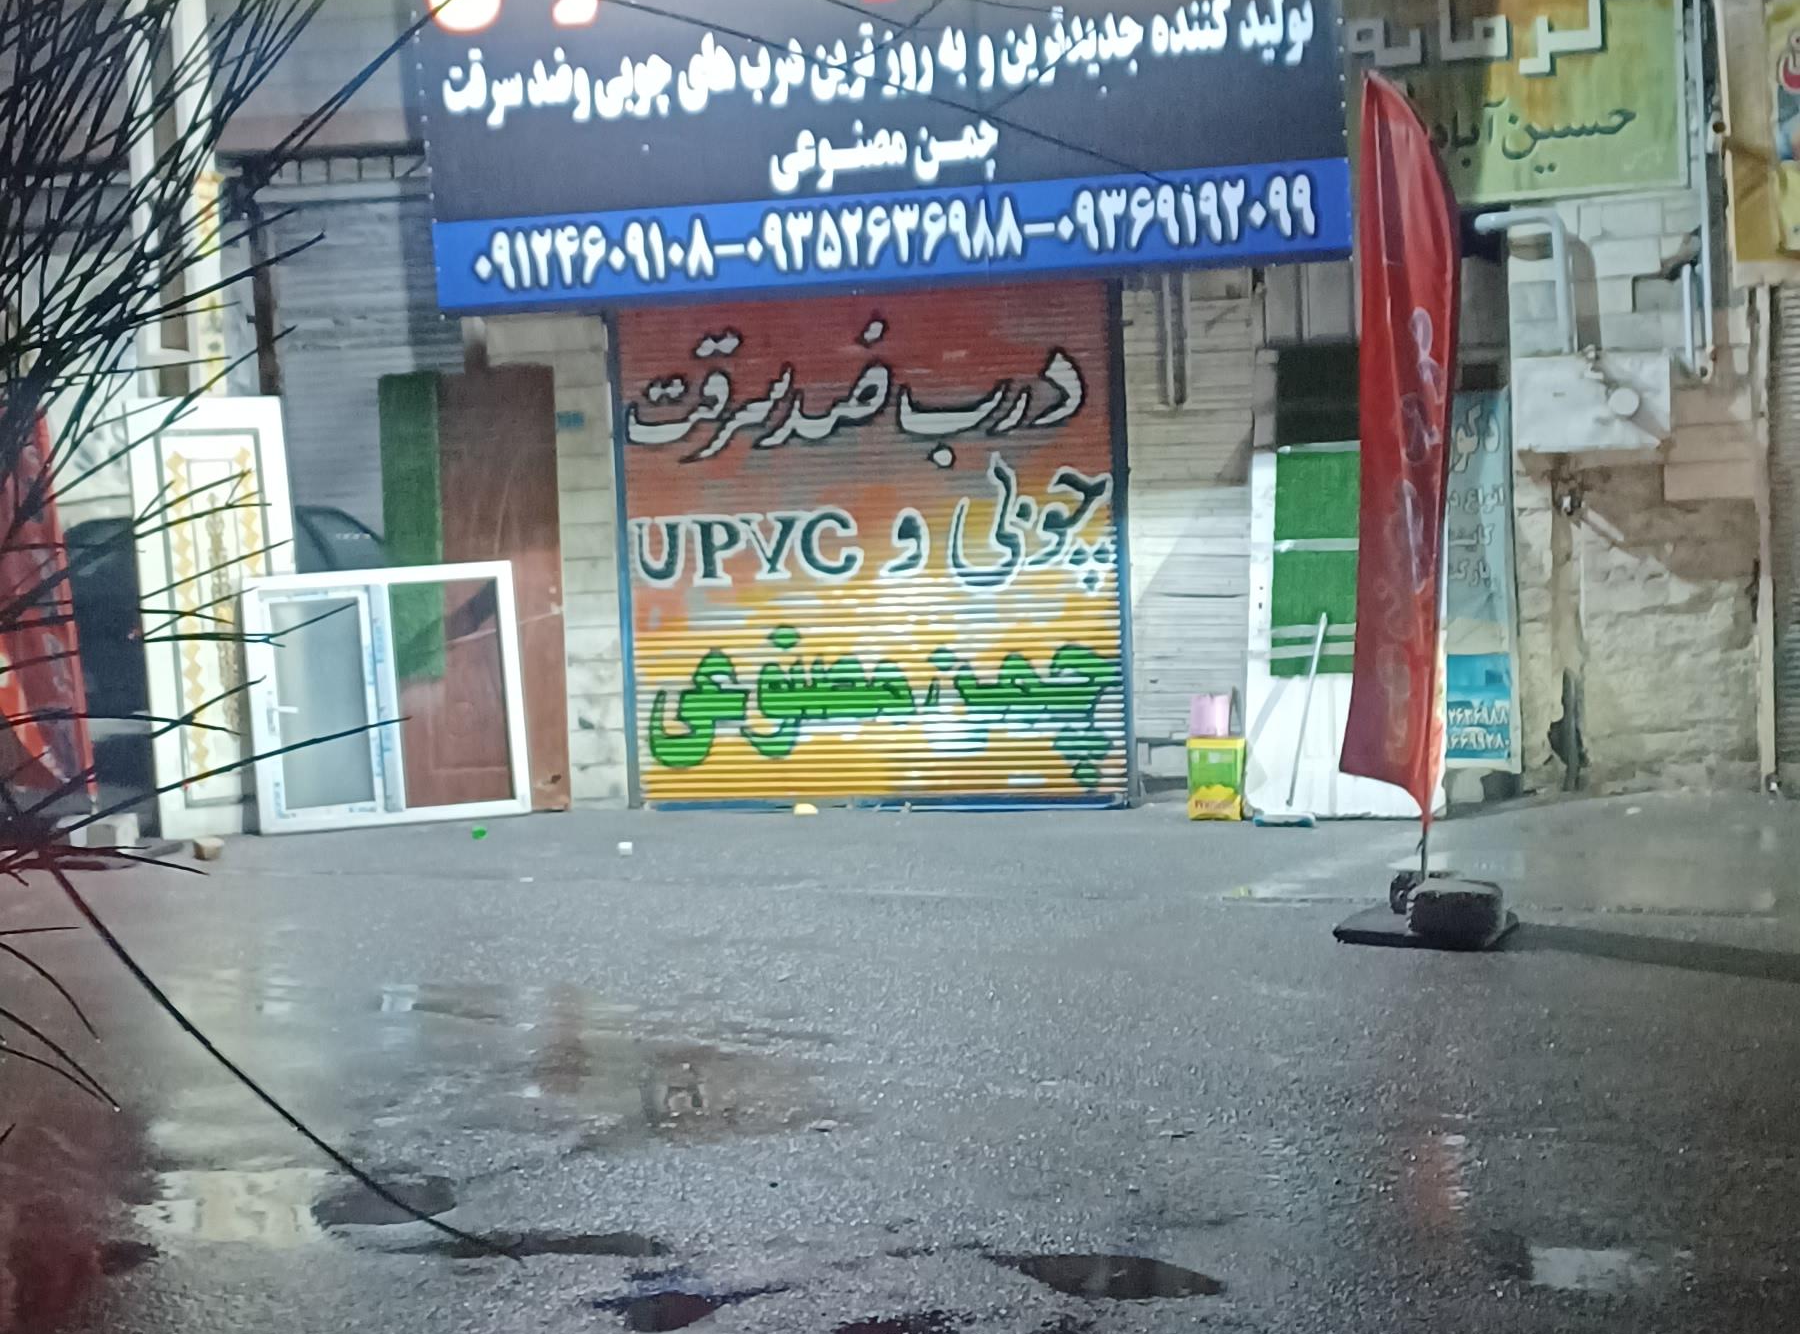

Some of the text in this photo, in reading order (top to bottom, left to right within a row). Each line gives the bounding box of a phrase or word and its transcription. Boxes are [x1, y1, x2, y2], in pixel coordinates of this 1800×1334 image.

[678, 32, 736, 113] های
[740, 38, 806, 106] درب
[811, 22, 876, 100] ترین
[881, 30, 934, 96] روز
[938, 26, 967, 87] به
[978, 34, 996, 88] و
[1000, 6, 1143, 85] جدیدترین
[442, 49, 523, 128] سرقت
[594, 53, 672, 118] چوبی
[769, 118, 999, 192] چمن مصنوعی
[1501, 108, 1636, 174] حسین
[626, 317, 1086, 468] درب ضد سرقت
[629, 507, 865, 588] UPVC
[880, 507, 930, 577] و
[648, 624, 1121, 788] چمن مصنوعی
[1447, 707, 1509, 725] ۲۶۳۶۹۸۸
